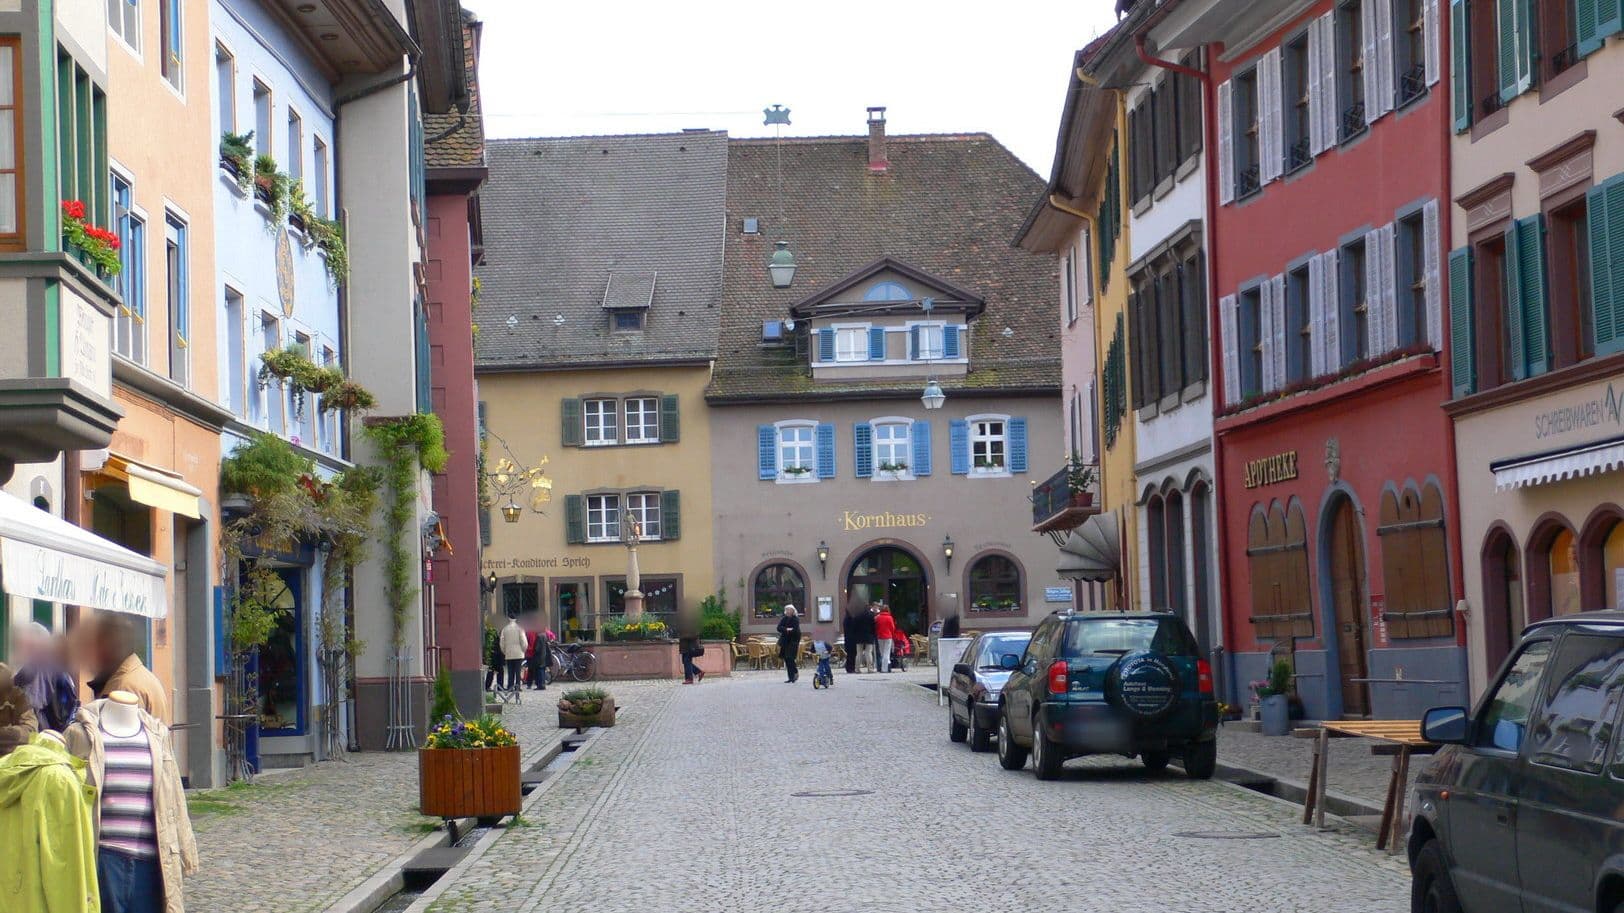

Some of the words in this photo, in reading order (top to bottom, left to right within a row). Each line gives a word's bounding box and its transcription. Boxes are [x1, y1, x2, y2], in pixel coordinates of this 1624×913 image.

[1535, 398, 1605, 440] SCHREIBWAREN
[1244, 450, 1297, 488] APOTHEKE
[843, 511, 926, 531] Kornhaus
[482, 557, 557, 569] ckerei-Konditorei
[562, 556, 591, 569] Sprich
